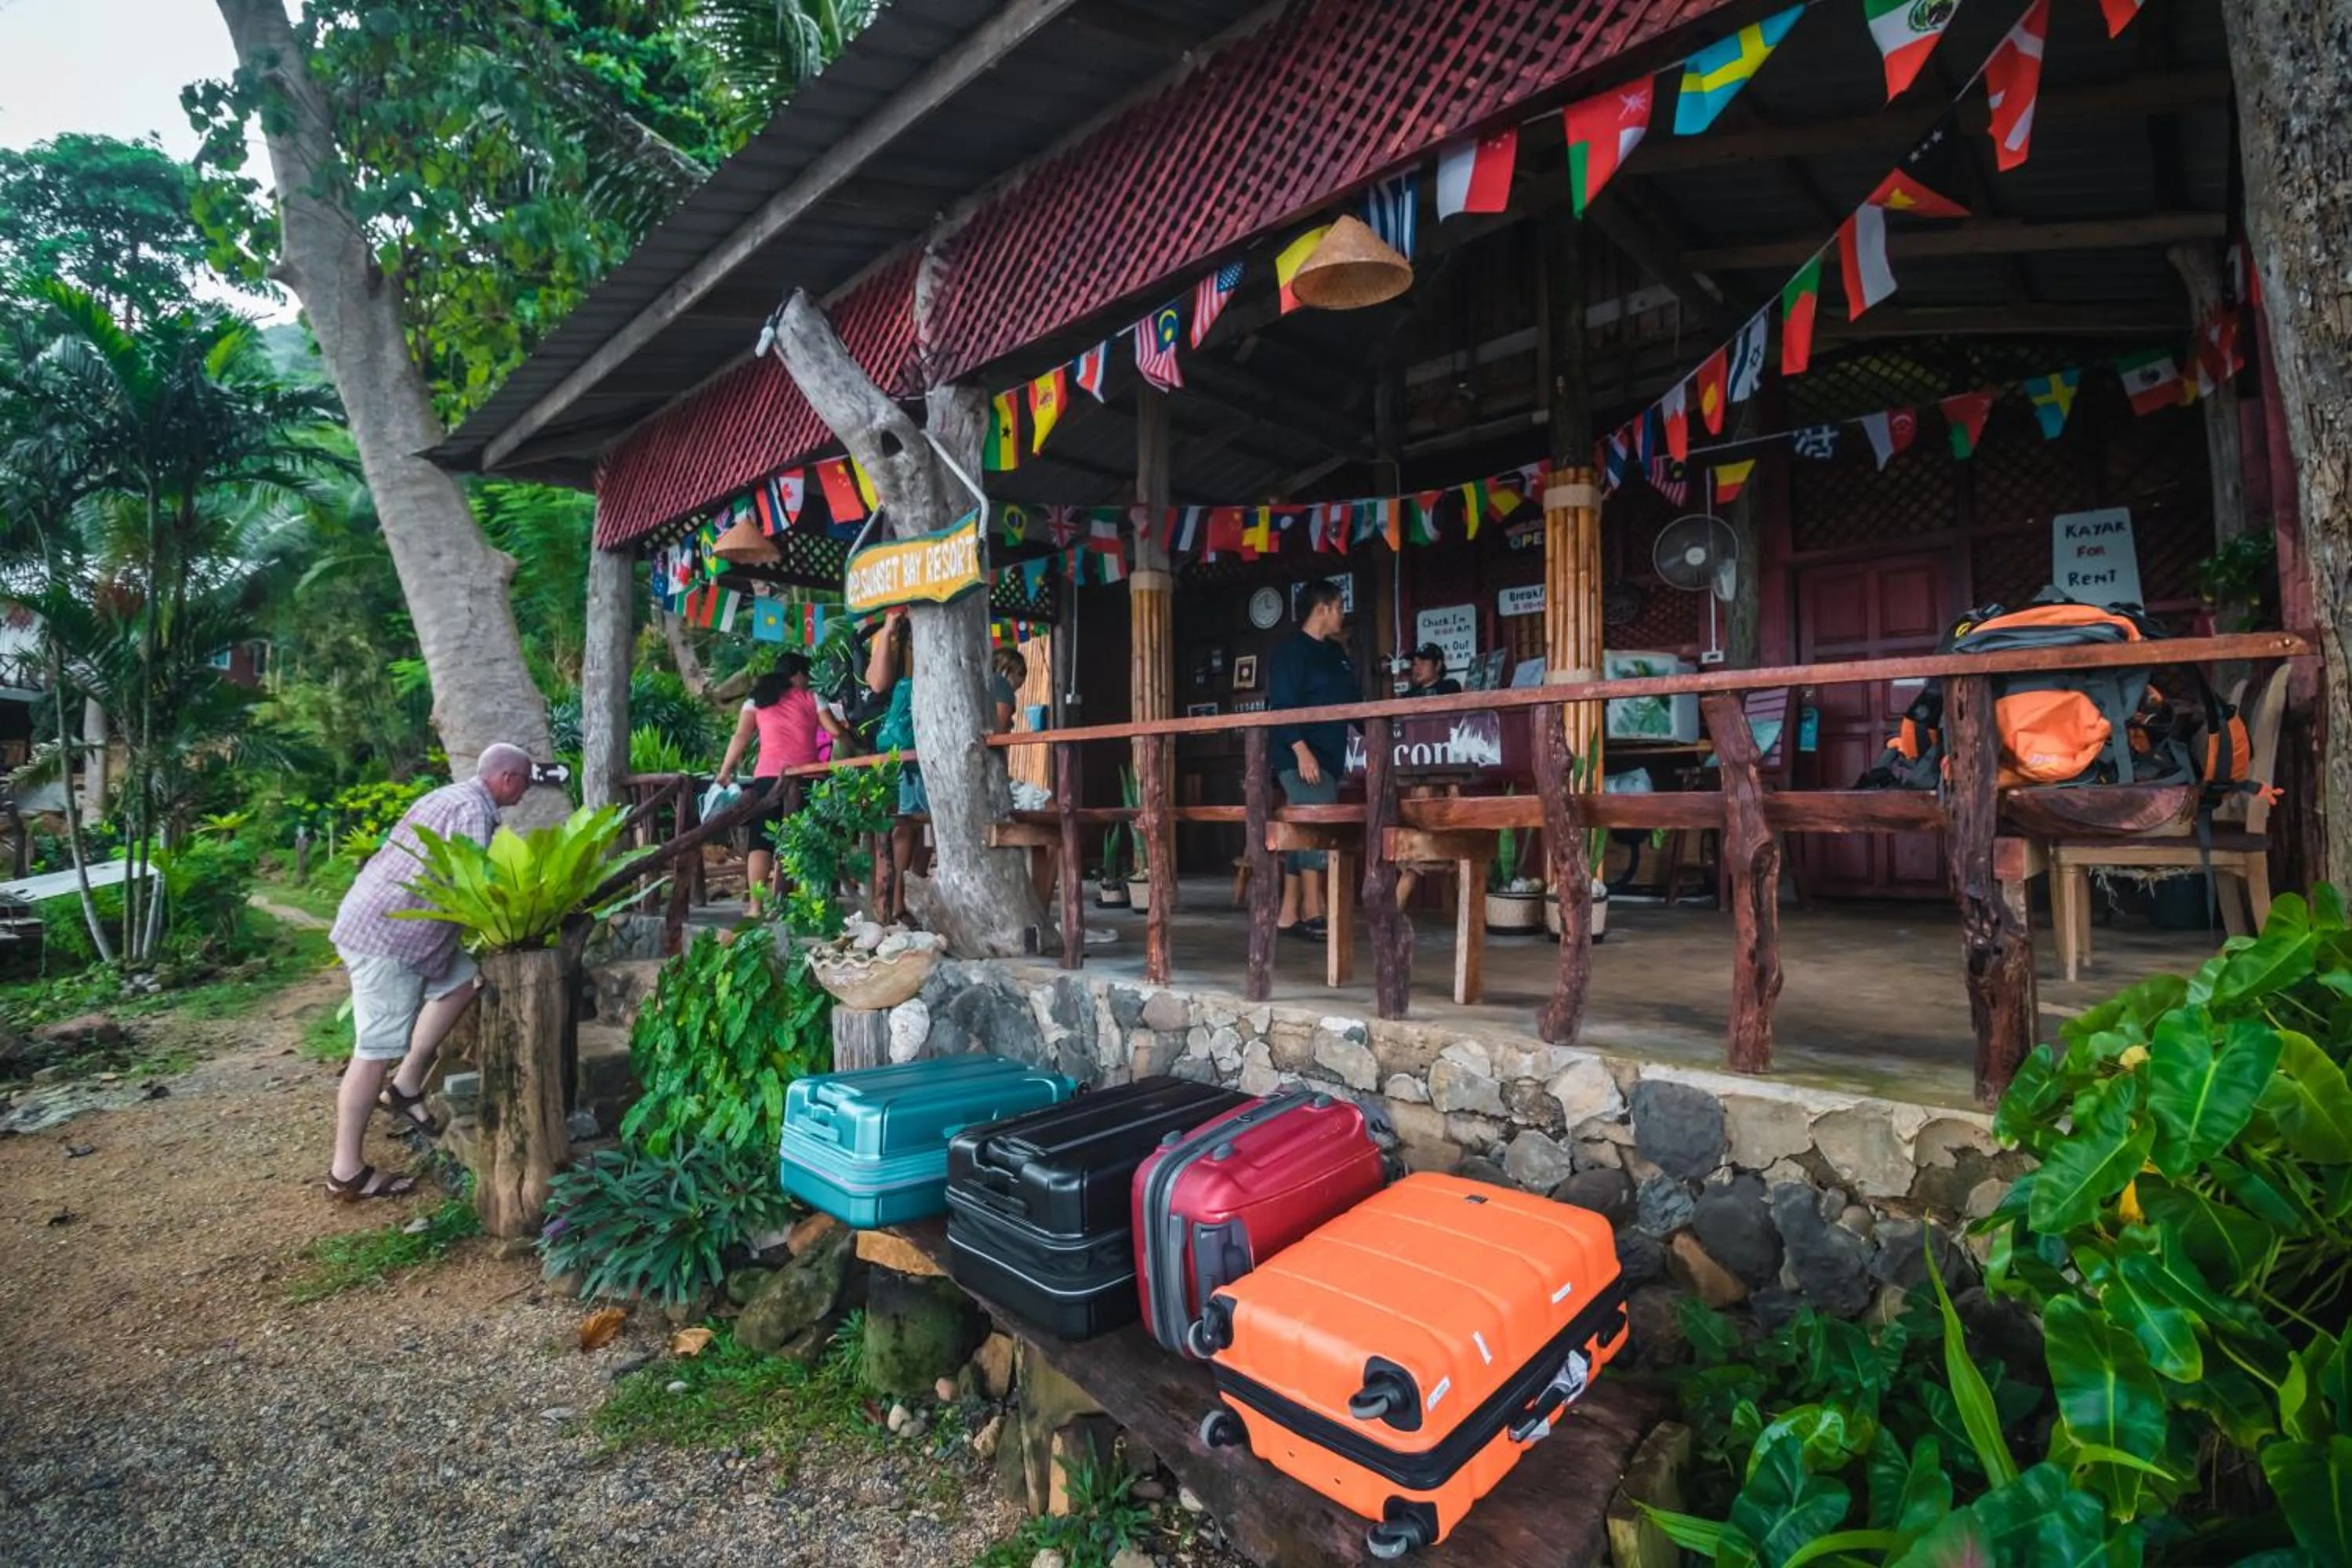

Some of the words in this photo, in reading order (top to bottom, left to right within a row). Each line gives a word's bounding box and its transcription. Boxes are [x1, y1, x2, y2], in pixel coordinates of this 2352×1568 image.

[2065, 521, 2126, 539] KAYAK
[1509, 531, 1544, 550] OPE
[926, 535, 976, 583] RESORT
[1509, 586, 1544, 603] Breakf
